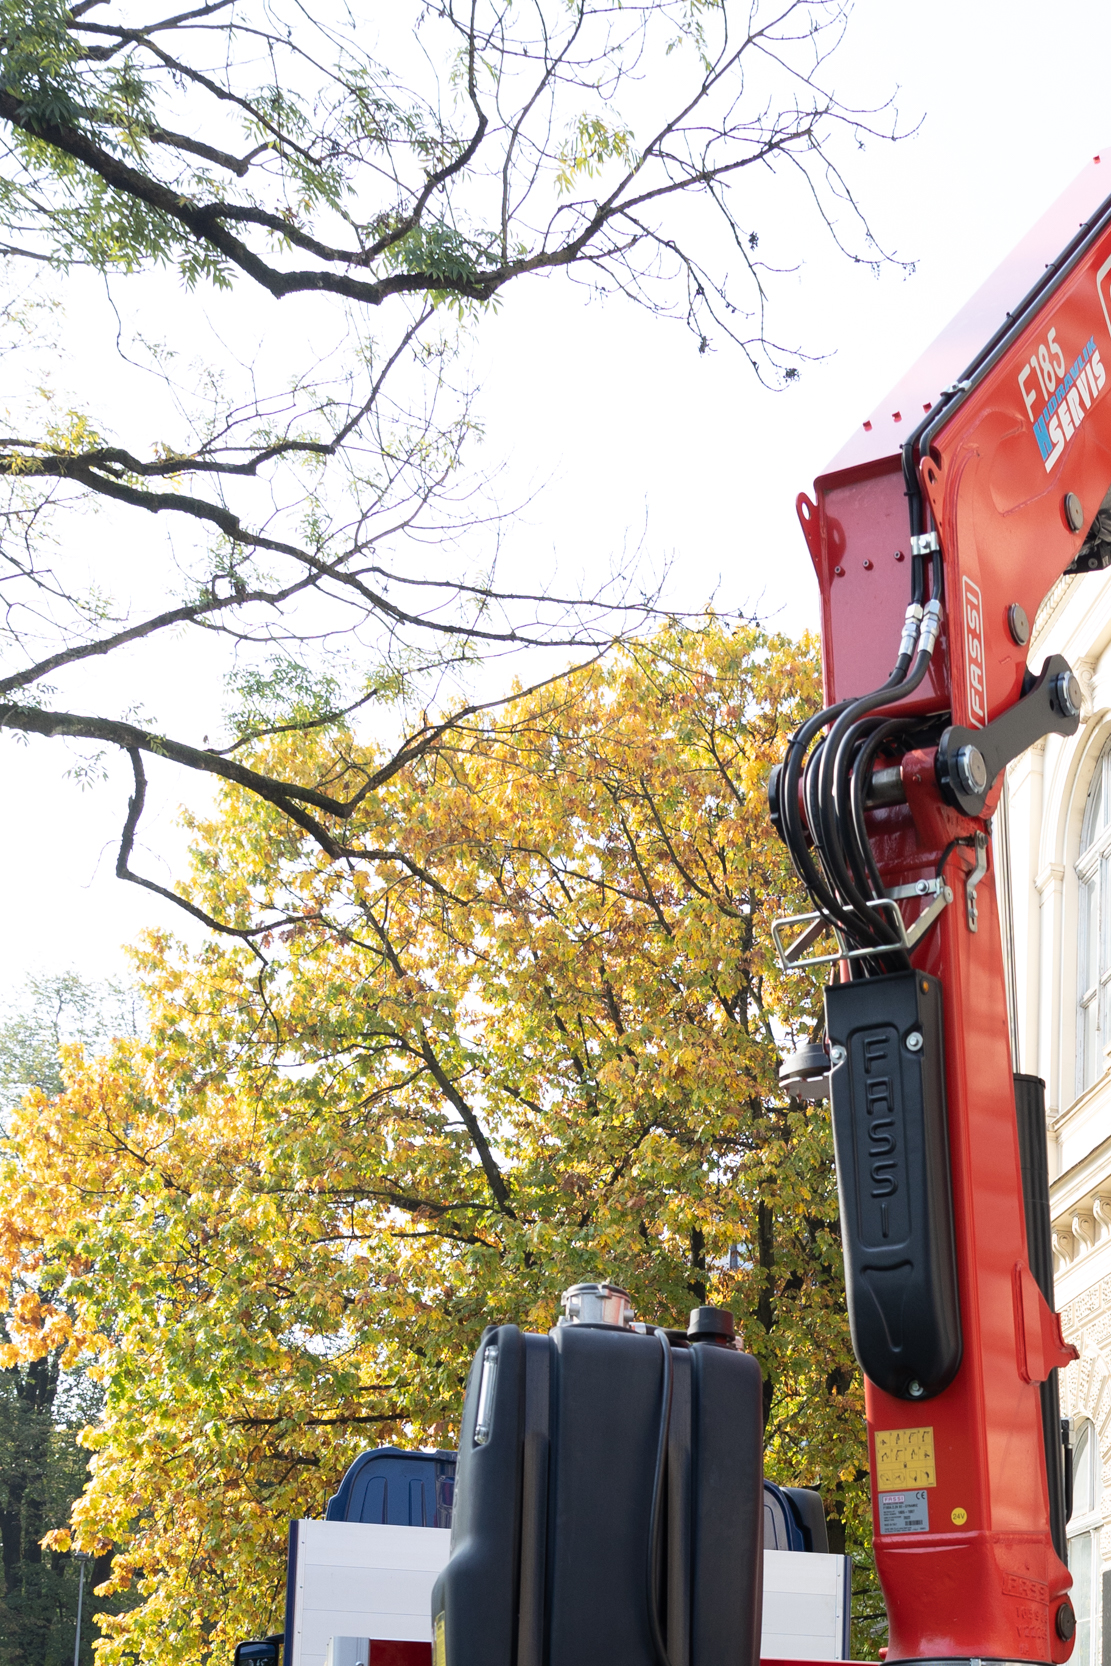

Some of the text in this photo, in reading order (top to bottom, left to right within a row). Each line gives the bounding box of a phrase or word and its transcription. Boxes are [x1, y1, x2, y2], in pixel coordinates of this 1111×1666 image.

[1032, 335, 1098, 462] HIDRAVLIK
[1044, 348, 1106, 474] SERVIS
[966, 591, 984, 718] FASSI
[862, 1034, 900, 1239] FASSI
[952, 1513, 965, 1521] 24V
